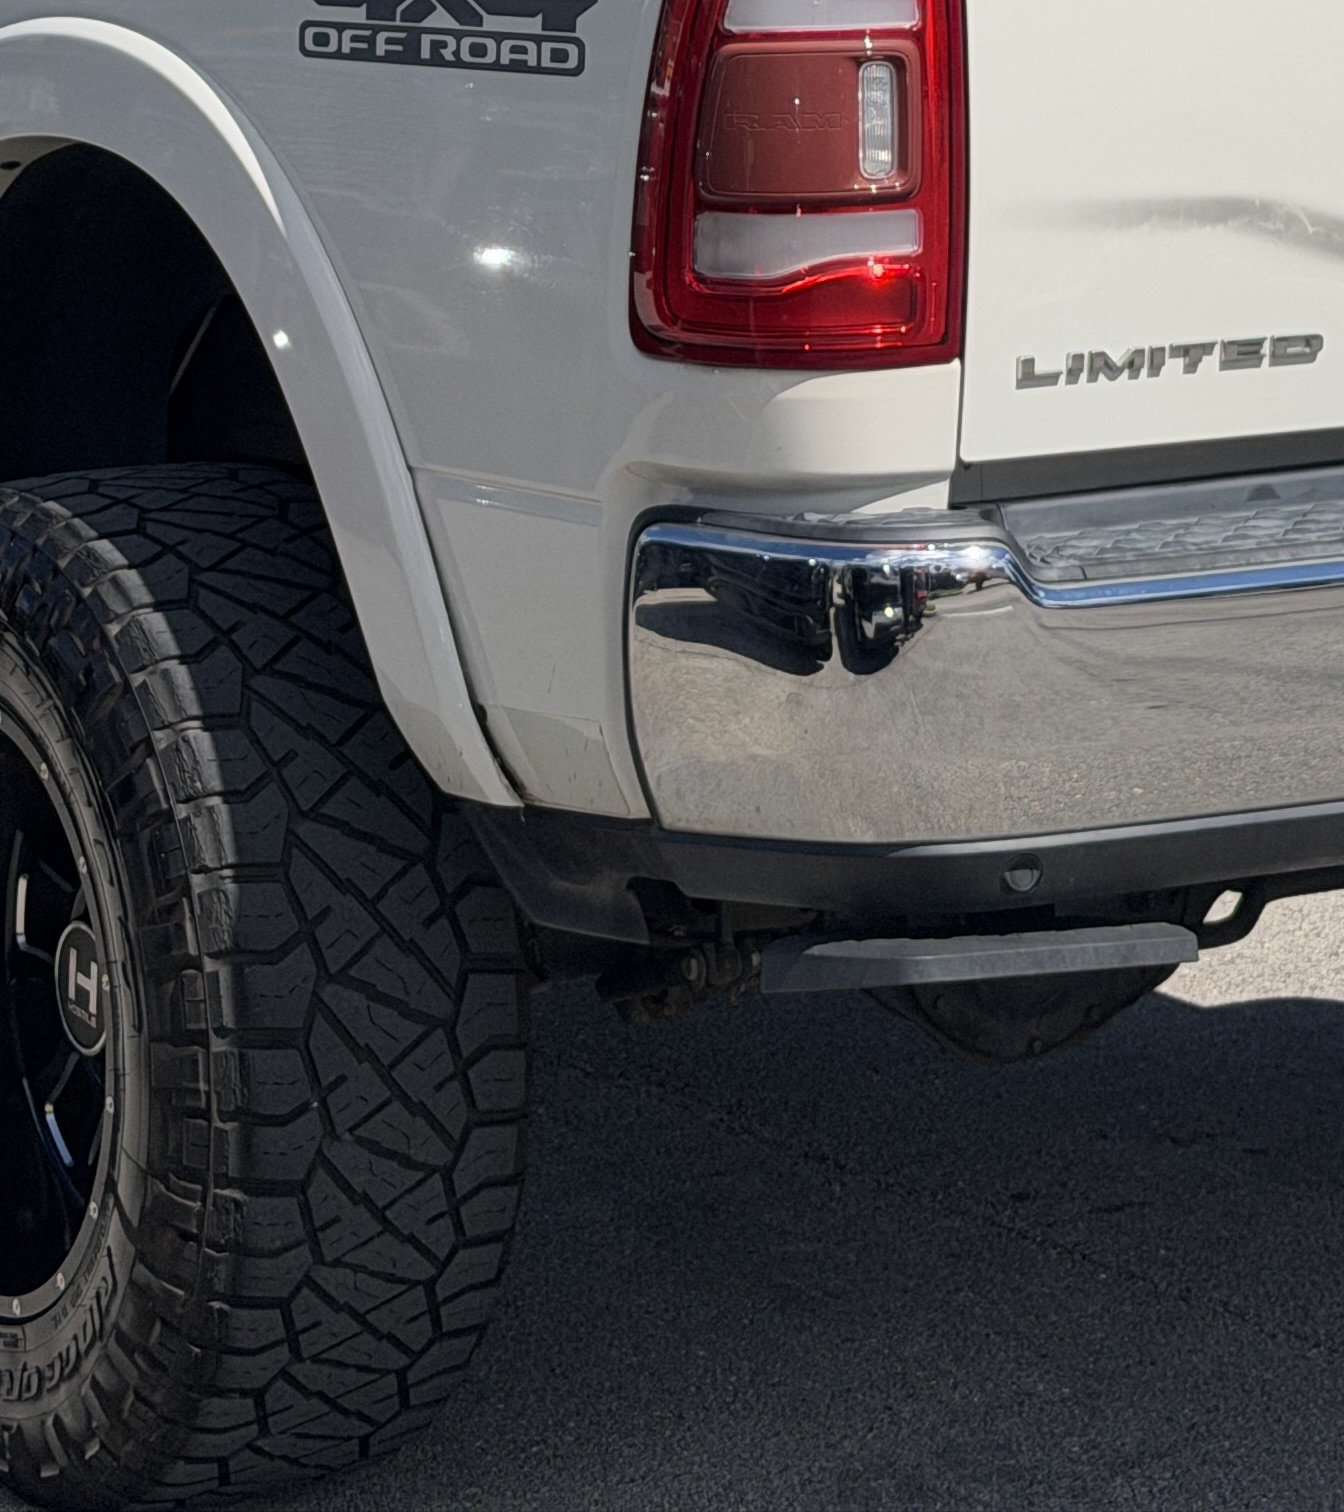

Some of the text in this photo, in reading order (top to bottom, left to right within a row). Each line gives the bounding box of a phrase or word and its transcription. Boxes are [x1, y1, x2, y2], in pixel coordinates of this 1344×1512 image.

[304, 25, 579, 70] OFF ROAD
[724, 112, 841, 131] RAM
[1015, 334, 1324, 390] LIMITED
